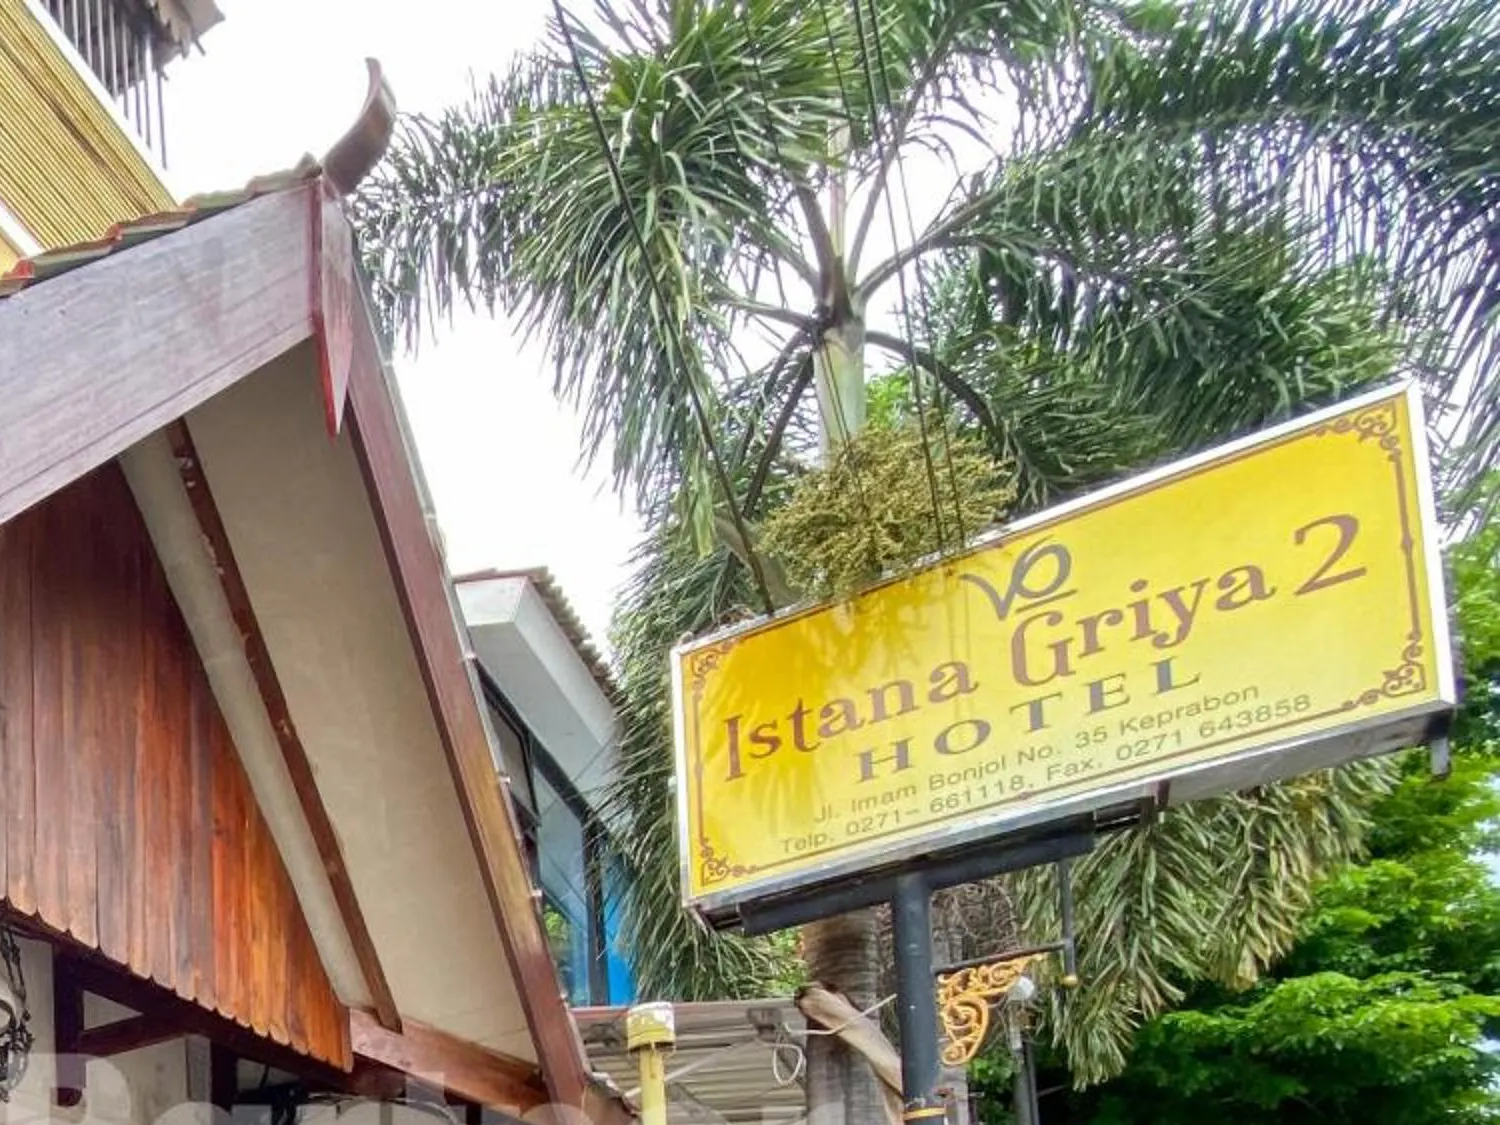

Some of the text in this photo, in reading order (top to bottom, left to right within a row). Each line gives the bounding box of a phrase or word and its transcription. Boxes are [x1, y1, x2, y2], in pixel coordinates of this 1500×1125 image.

[723, 513, 1368, 783] Istana Griya 2
[850, 784, 918, 813] Imam
[928, 754, 1007, 791] Bonjol
[1017, 744, 1062, 766] No.
[1074, 724, 1109, 749] 35
[1118, 684, 1261, 737] Keprabon
[855, 655, 1201, 783] HOTEL
[1046, 758, 1104, 782] Fax.
[1114, 728, 1184, 762] 0271
[1198, 692, 1313, 739] 643858
